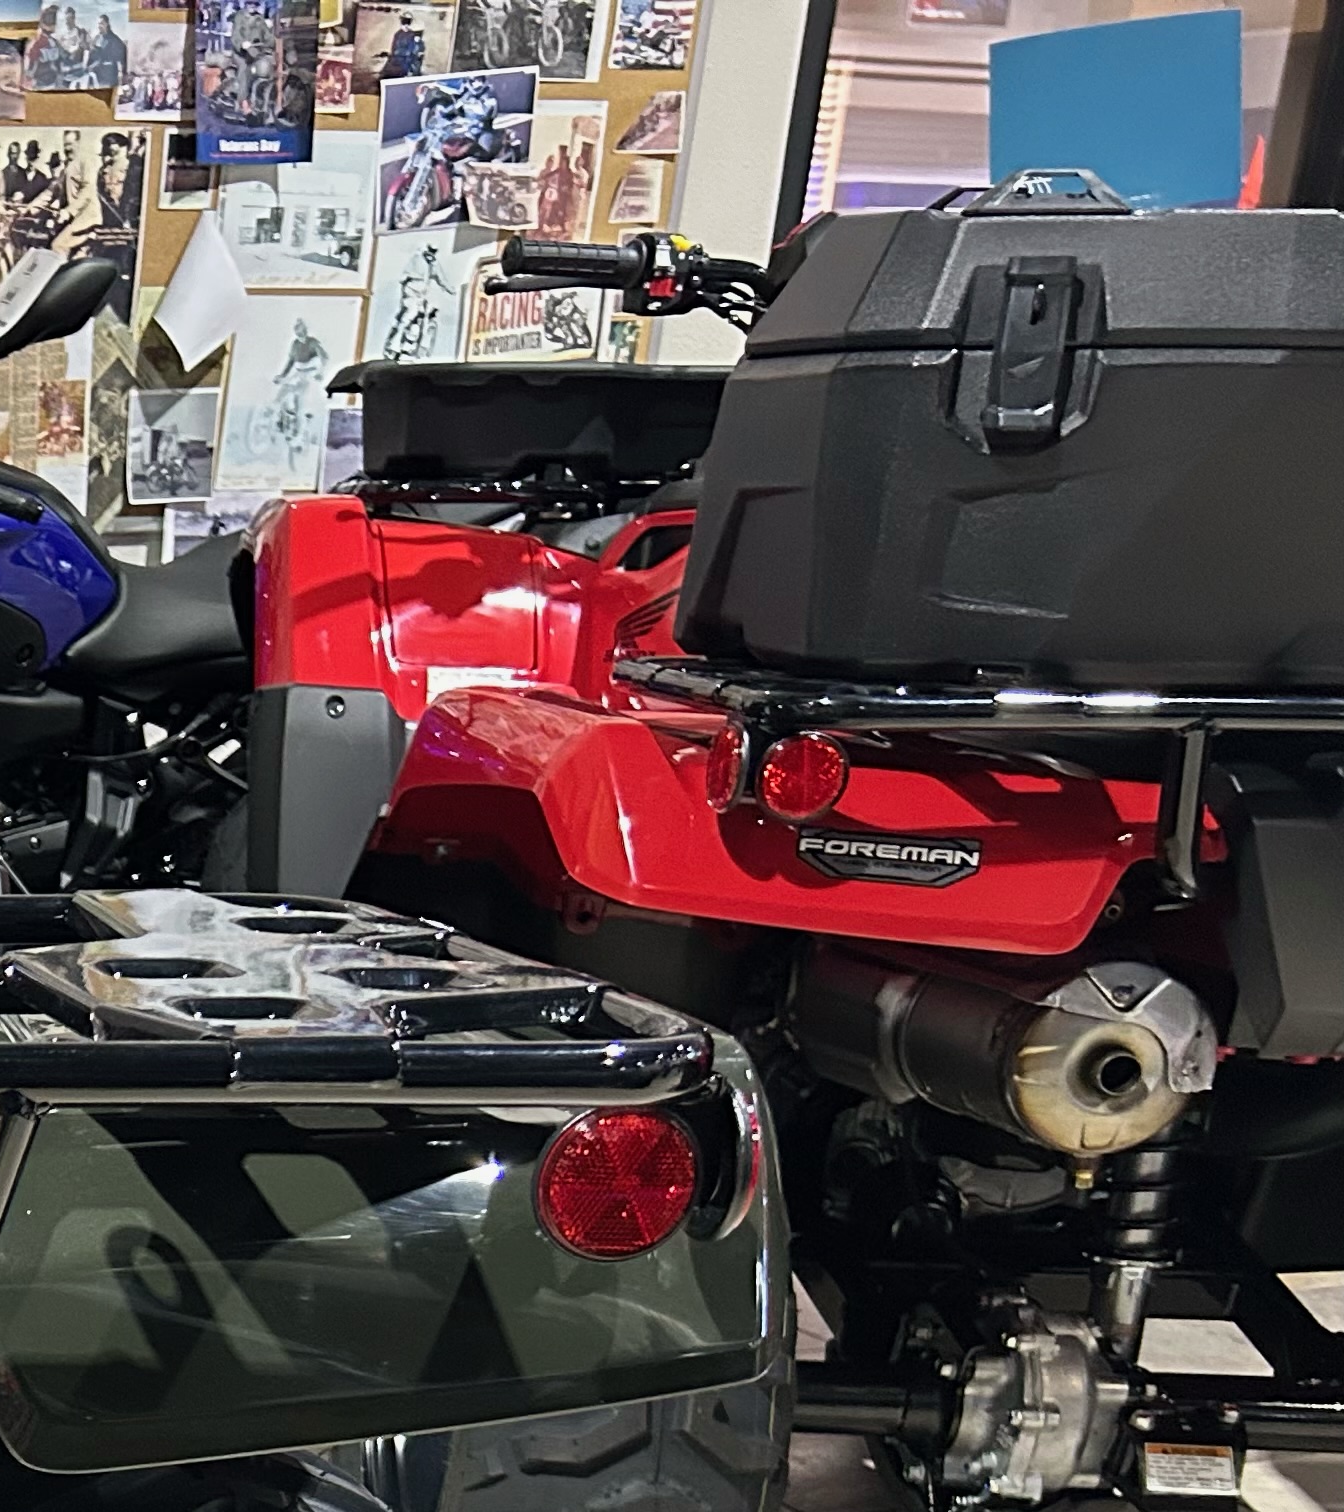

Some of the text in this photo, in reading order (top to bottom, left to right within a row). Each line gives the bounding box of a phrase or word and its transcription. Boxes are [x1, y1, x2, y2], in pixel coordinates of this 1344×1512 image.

[218, 139, 281, 152] Veterans Day
[476, 290, 542, 333] RACING
[799, 837, 980, 866] FOREMAN
